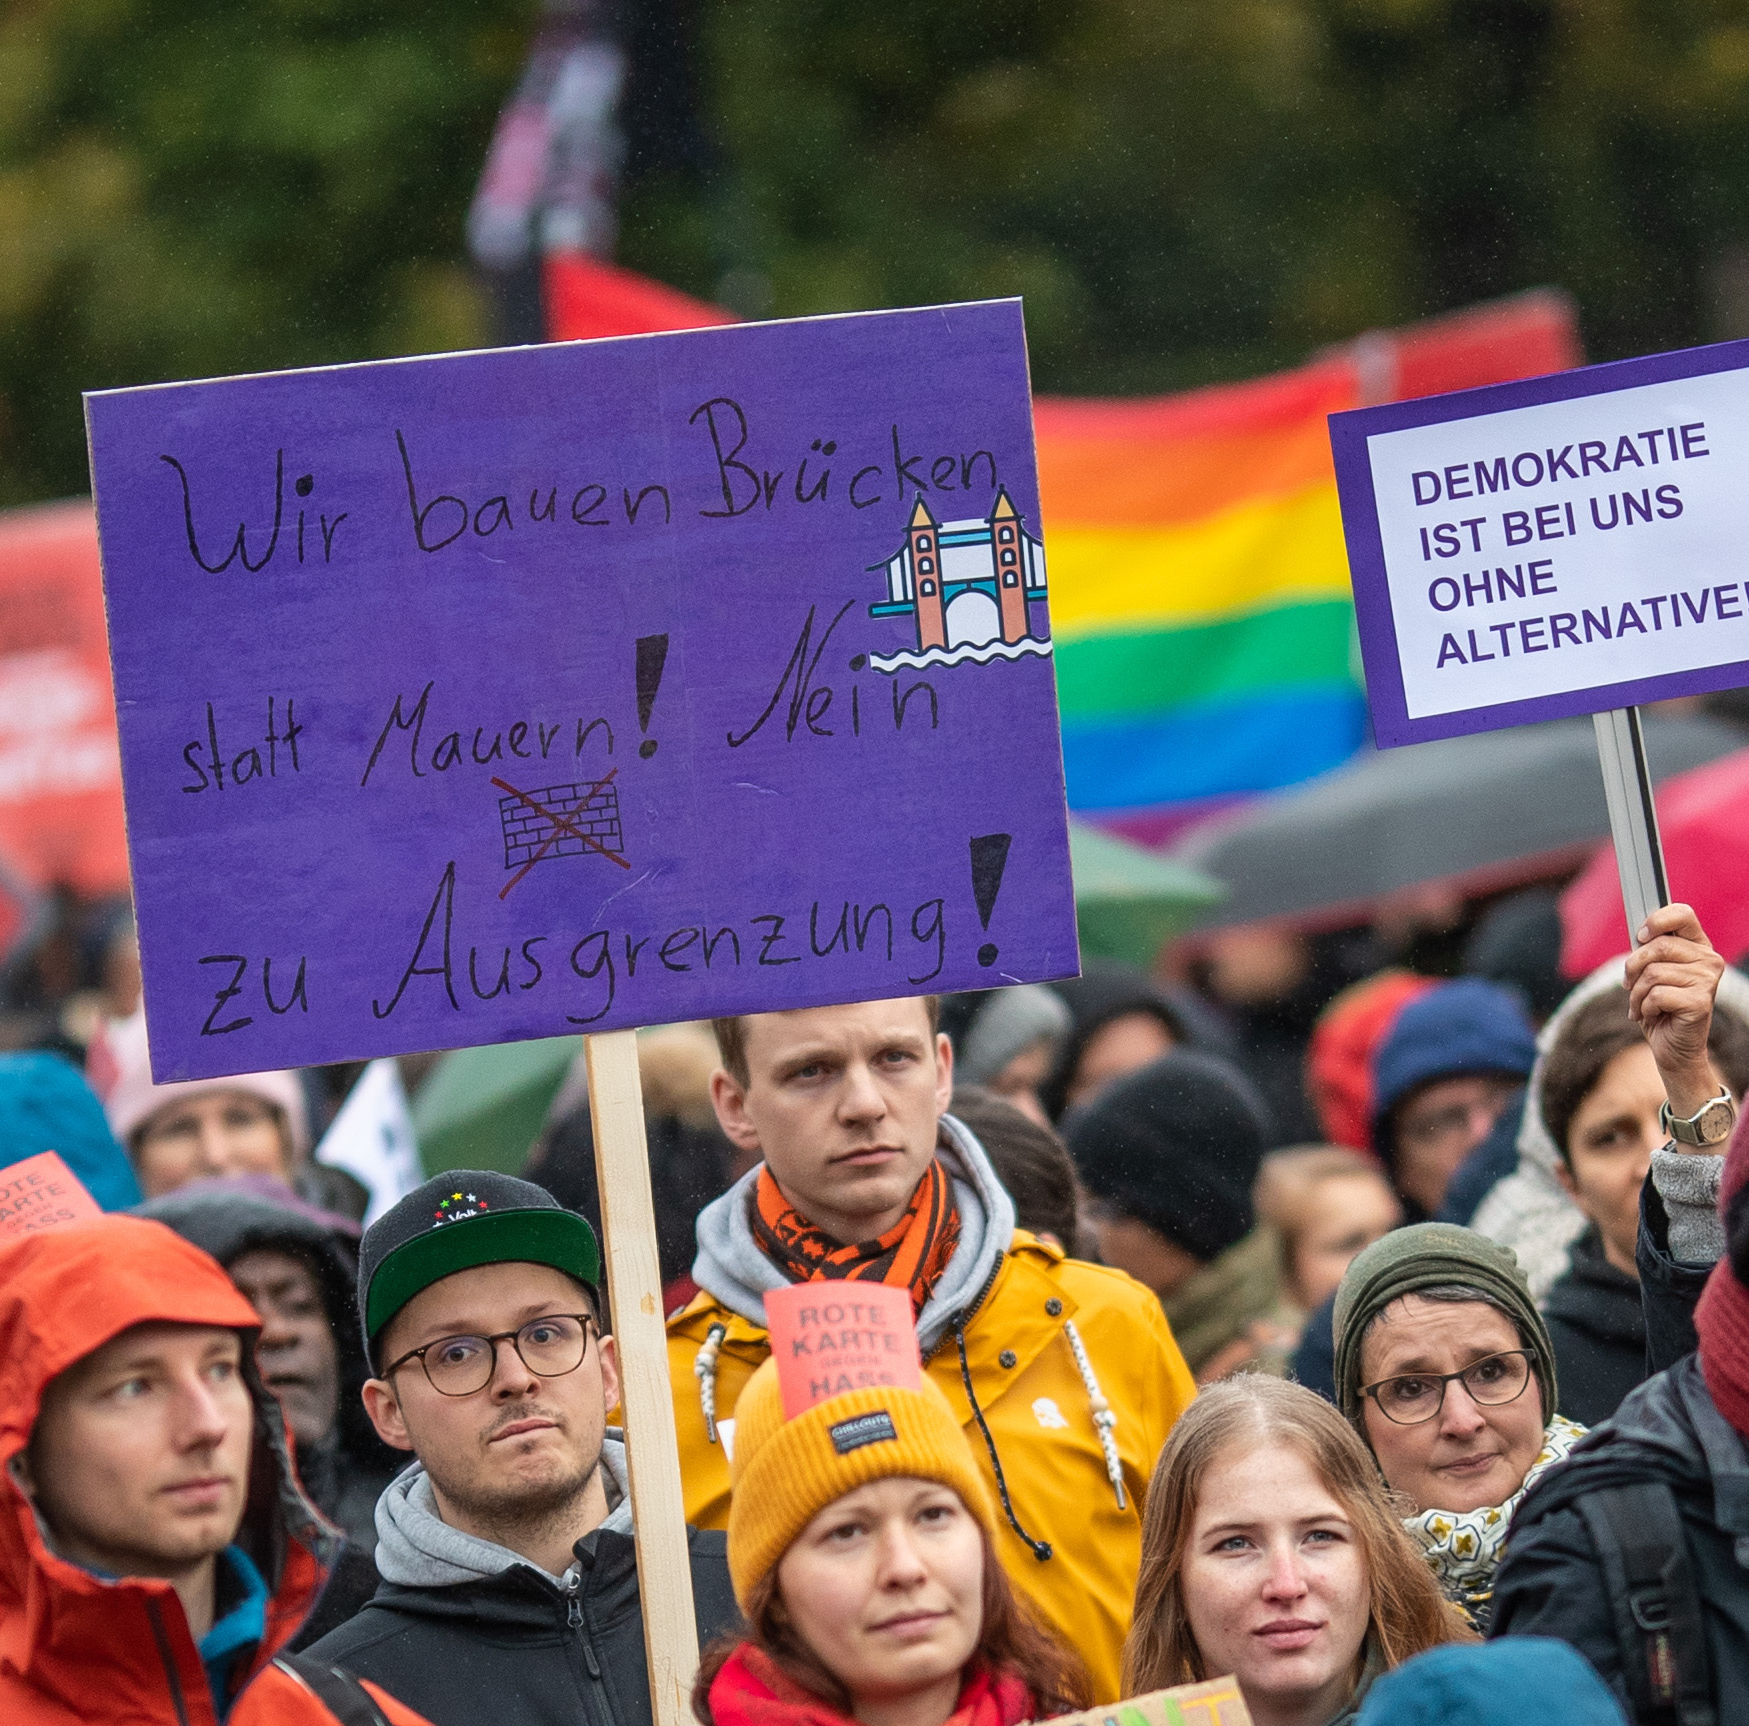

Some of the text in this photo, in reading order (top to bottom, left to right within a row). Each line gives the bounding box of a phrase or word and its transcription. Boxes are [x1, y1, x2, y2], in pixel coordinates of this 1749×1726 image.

[160, 397, 997, 574] Wir bauen Brücken
[1411, 421, 1710, 506] DEMOKRATIE
[1420, 484, 1685, 562] IST BEI UNS
[1427, 559, 1558, 612] OHNE
[182, 698, 305, 794] statt
[361, 633, 669, 786] Mauern!
[727, 600, 940, 747] Nein
[199, 951, 309, 1036] zu
[791, 1327, 901, 1358] KARTE
[798, 1302, 887, 1329] ROTE
[809, 1371, 895, 1399] HASS
